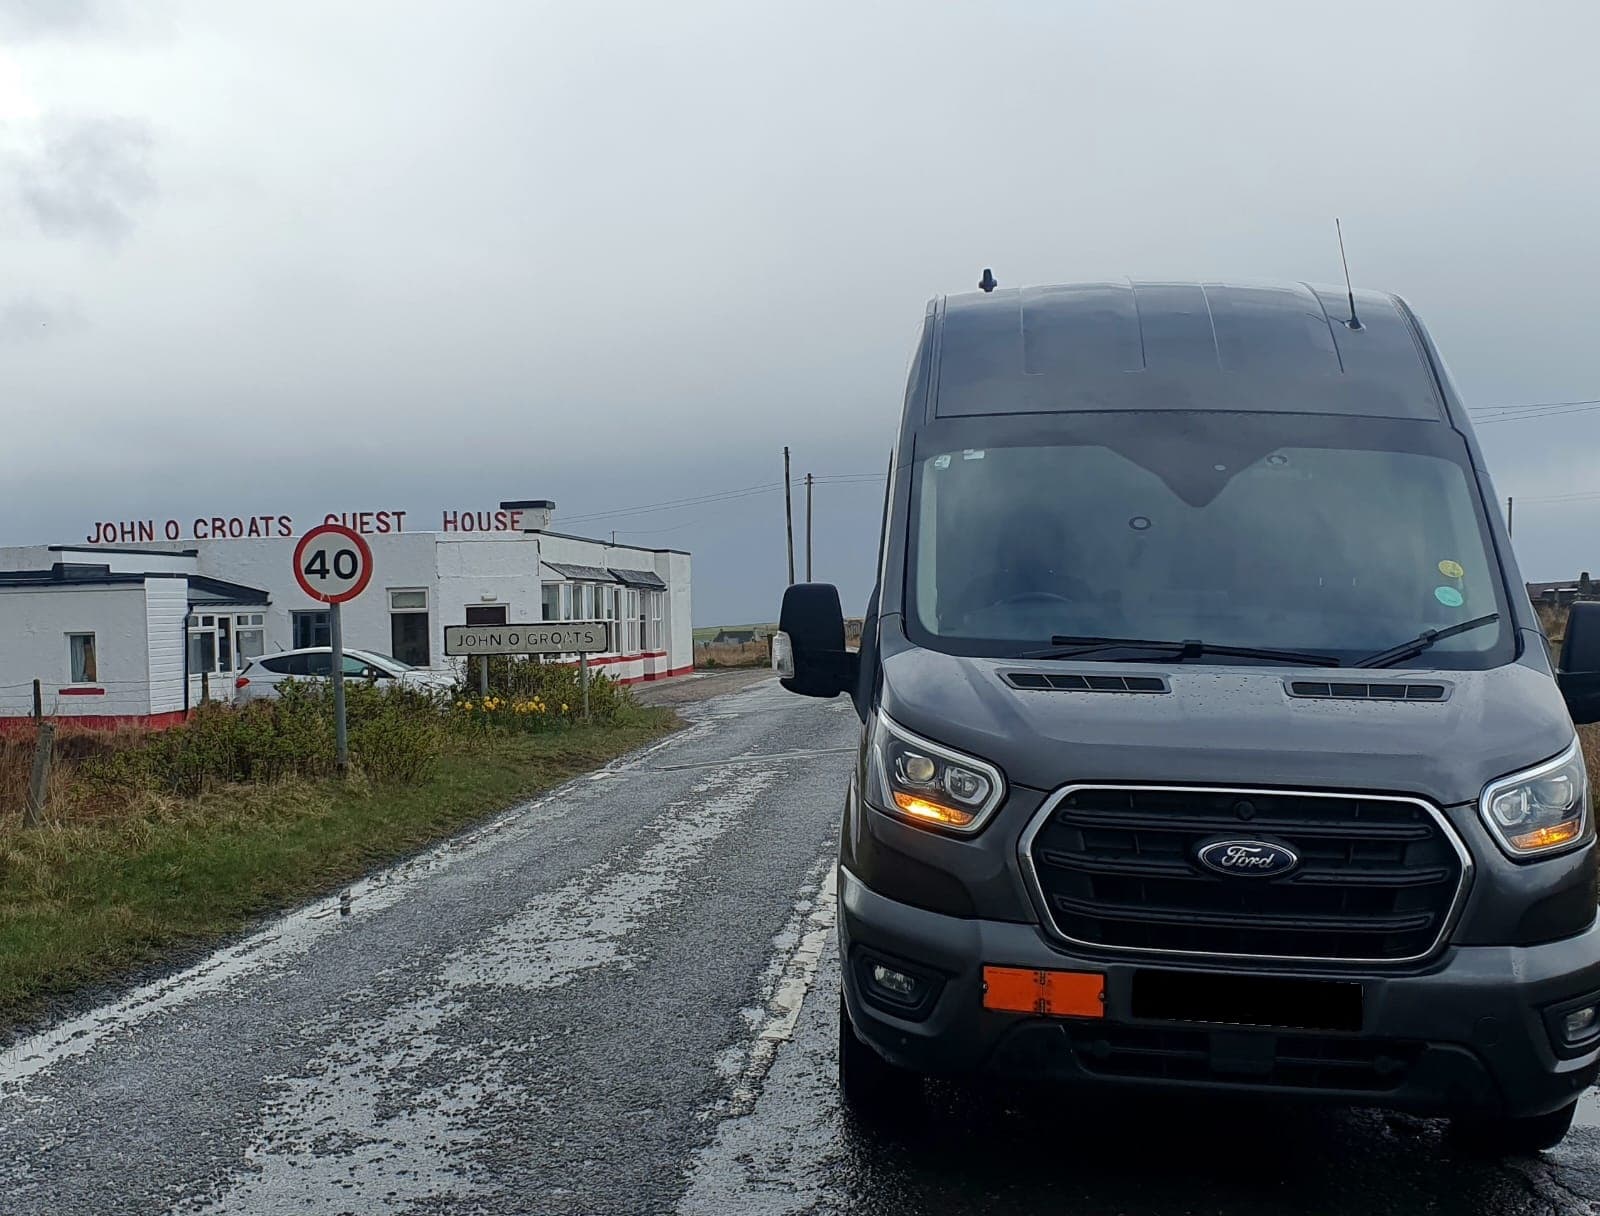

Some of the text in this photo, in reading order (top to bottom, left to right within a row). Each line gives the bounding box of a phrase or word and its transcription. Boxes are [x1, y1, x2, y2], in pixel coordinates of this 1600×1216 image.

[86, 520, 154, 544] JOHN
[165, 520, 180, 540] O
[443, 511, 524, 532] HOUSE
[304, 549, 359, 580] 40
[457, 631, 594, 647] JOHN O GROATS
[1221, 846, 1275, 869] Ford
